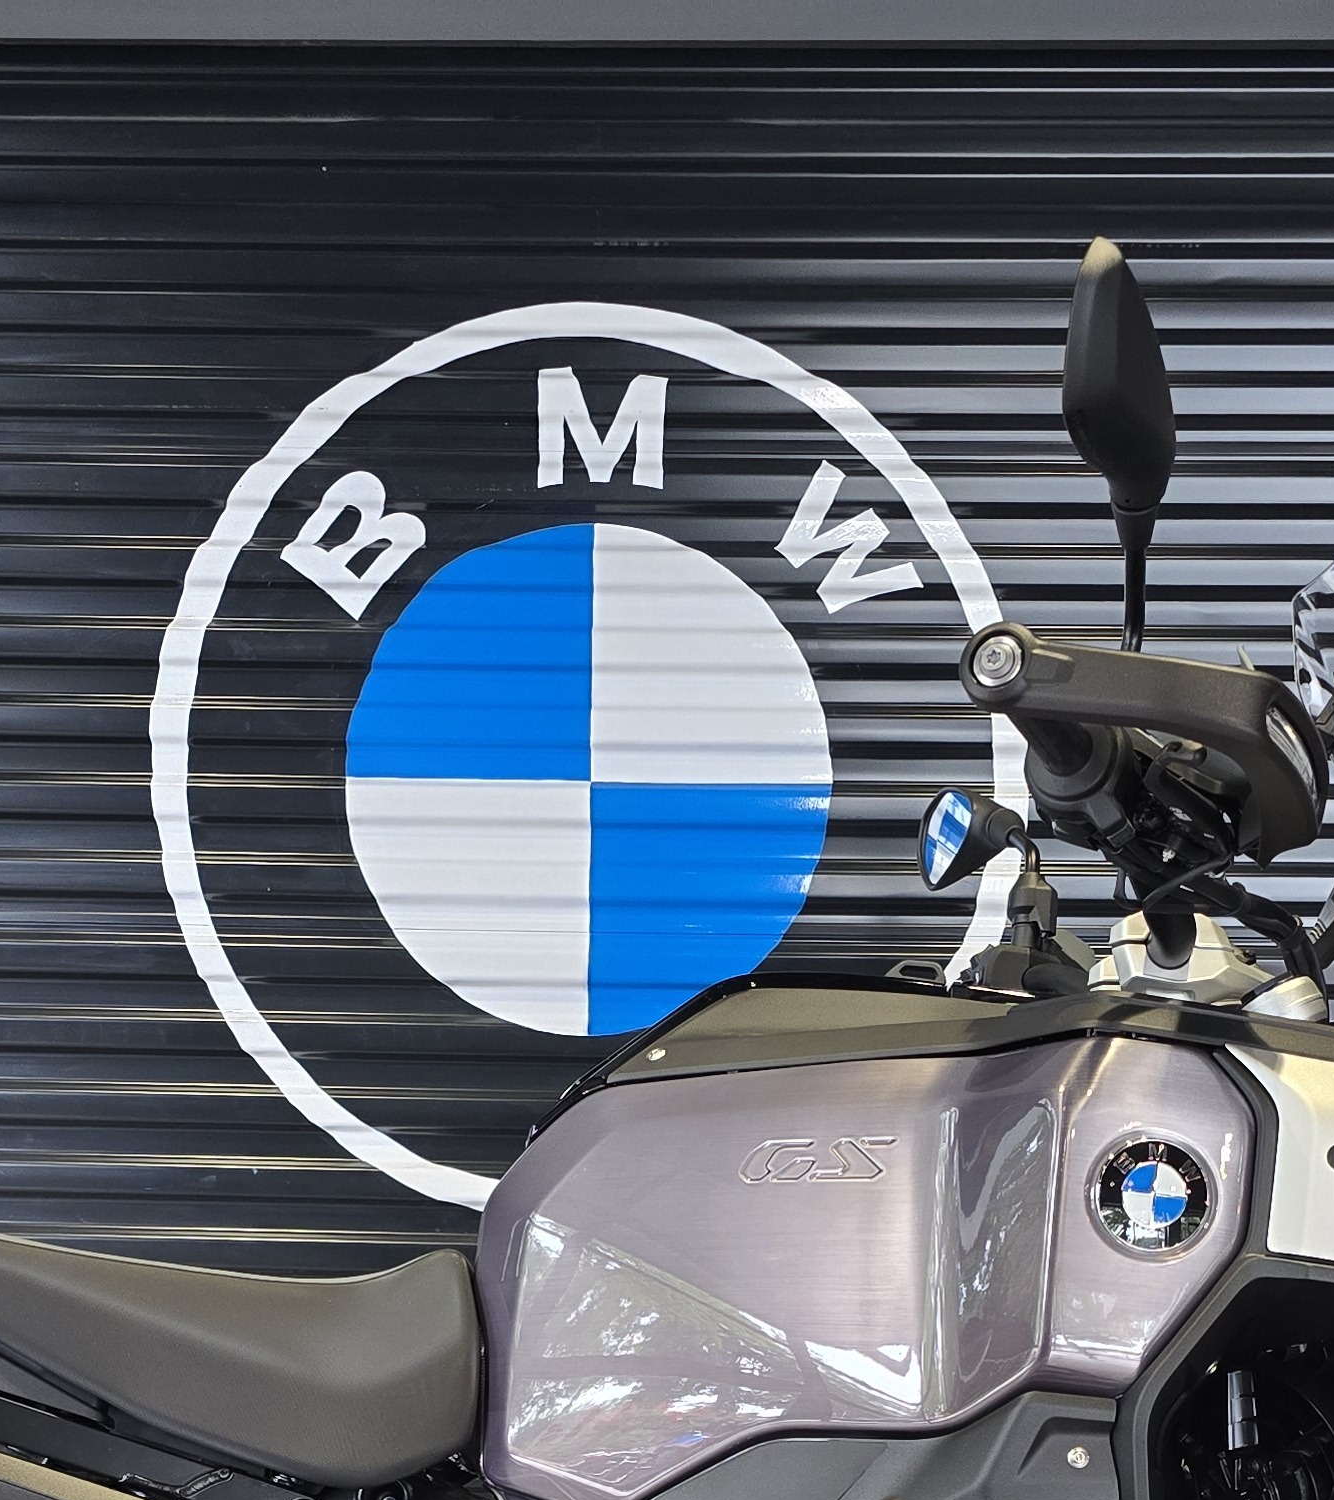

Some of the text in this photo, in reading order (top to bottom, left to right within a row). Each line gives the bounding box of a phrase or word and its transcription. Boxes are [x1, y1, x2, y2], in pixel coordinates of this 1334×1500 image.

[280, 366, 923, 620] BMW
[738, 1136, 898, 1184] GS
[1113, 1143, 1201, 1183] BMW
